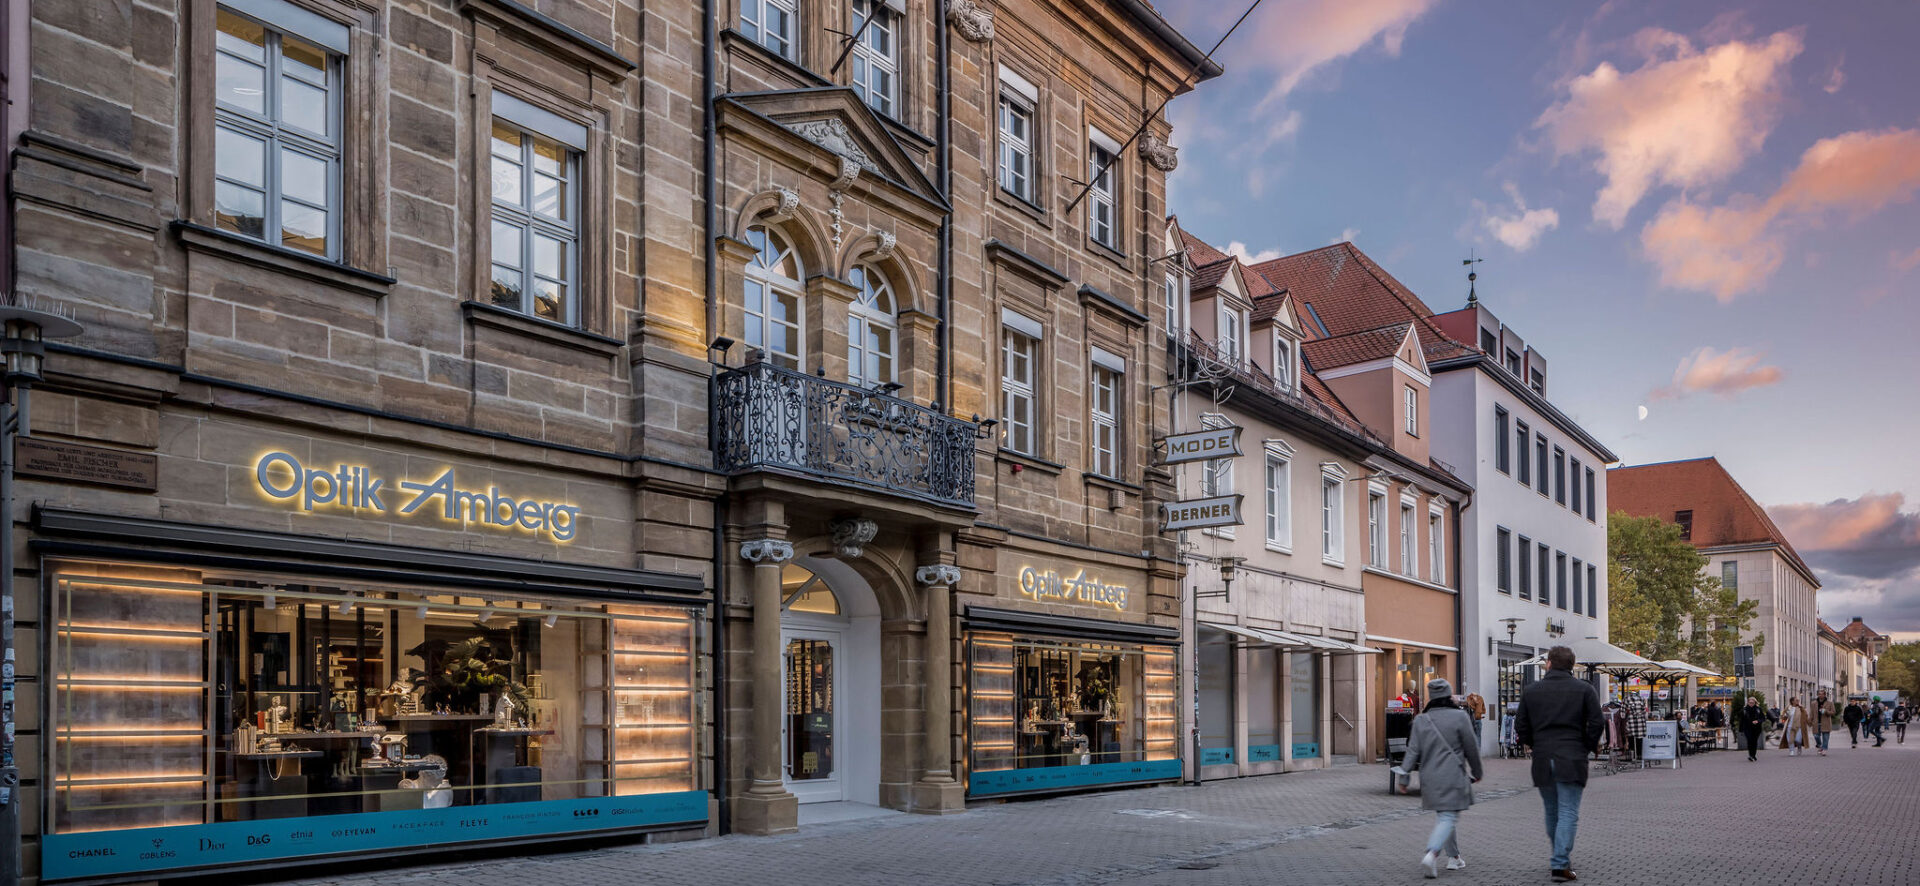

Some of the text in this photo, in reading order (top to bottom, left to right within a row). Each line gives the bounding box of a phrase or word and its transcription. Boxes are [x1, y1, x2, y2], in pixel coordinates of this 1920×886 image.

[1171, 436, 1230, 455] MODE
[57, 453, 79, 462] EMIL
[257, 451, 581, 541] Optik Amberg
[1171, 504, 1231, 522] BERNER
[1022, 567, 1129, 609] Optik Amberg
[460, 818, 489, 828] FLEYE
[290, 830, 313, 839] etnia
[344, 827, 376, 837] EYEVAN
[247, 834, 271, 846] D&G
[69, 848, 117, 859] CHANEL
[139, 850, 176, 860] COBLENS
